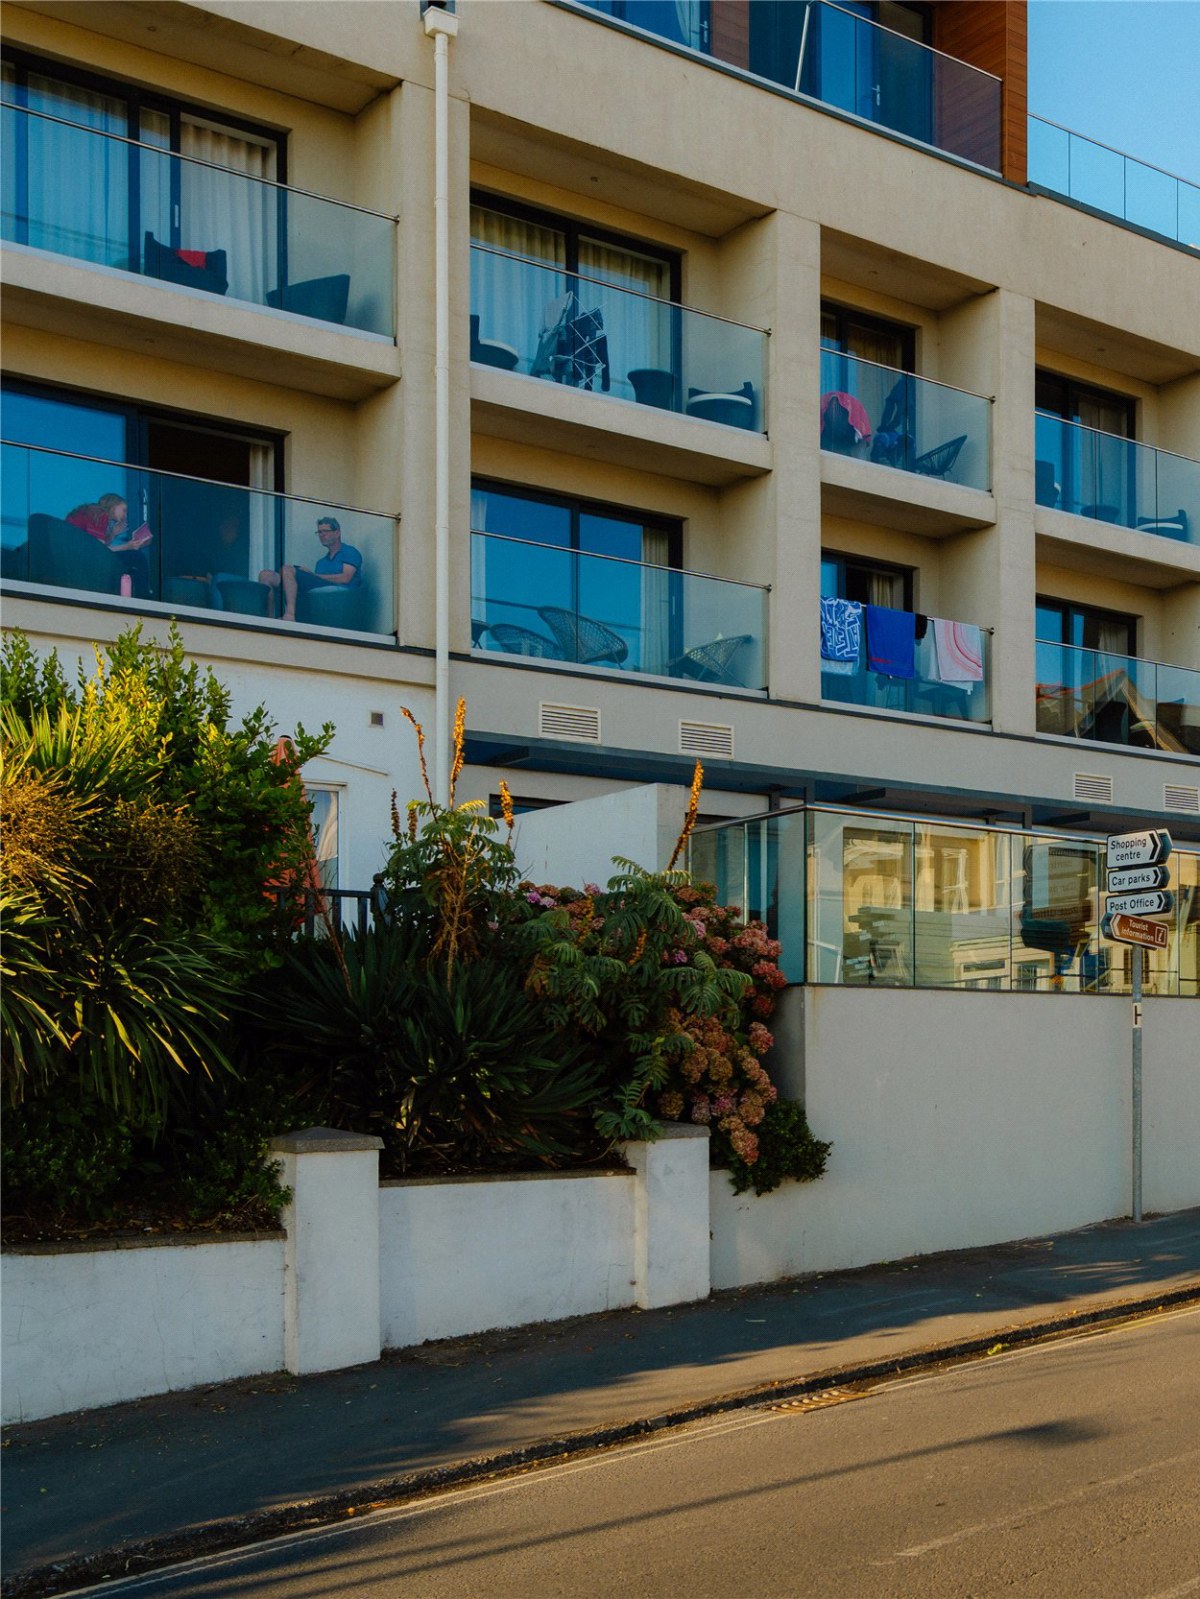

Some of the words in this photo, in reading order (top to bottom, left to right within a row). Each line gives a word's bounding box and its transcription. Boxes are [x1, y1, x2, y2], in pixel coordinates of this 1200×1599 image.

[1110, 838, 1147, 850] Shopping
[1115, 850, 1141, 861] centre
[1111, 876, 1126, 886] Car
[1128, 873, 1151, 886] parks
[1110, 901, 1127, 911] Post
[1129, 898, 1155, 909] Office
[1128, 919, 1149, 931] Tourist
[1122, 928, 1154, 942] information
